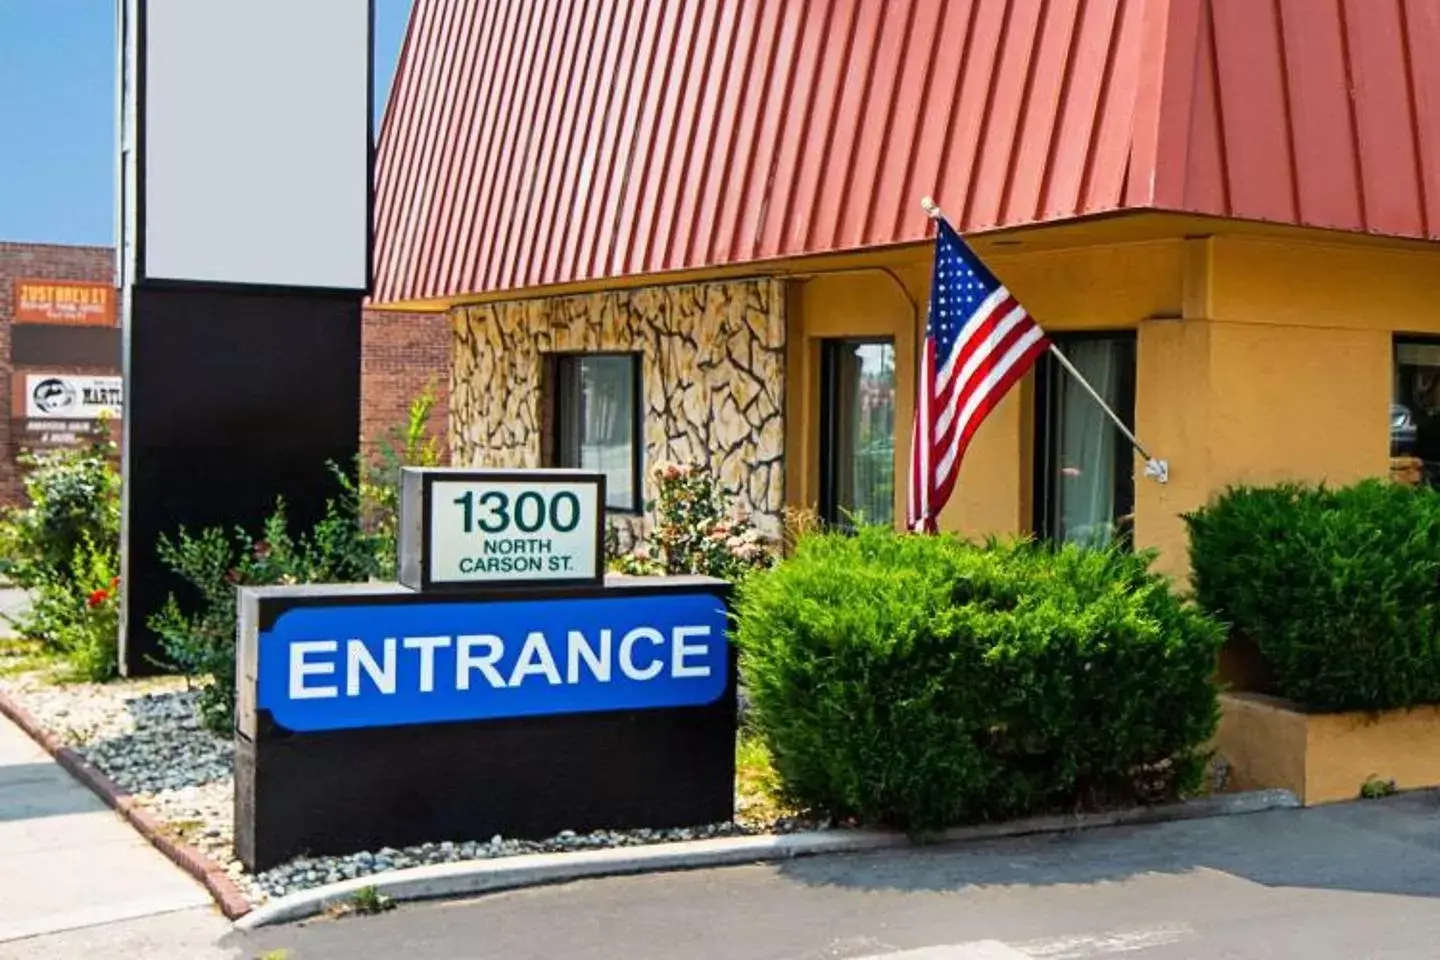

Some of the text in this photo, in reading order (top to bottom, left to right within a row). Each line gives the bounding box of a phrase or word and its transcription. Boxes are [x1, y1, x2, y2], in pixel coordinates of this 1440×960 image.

[453, 490, 581, 534] 1300
[483, 538, 552, 555] NORTH
[459, 554, 574, 574] CARSON ST.
[289, 626, 711, 700] ENTRANCE
